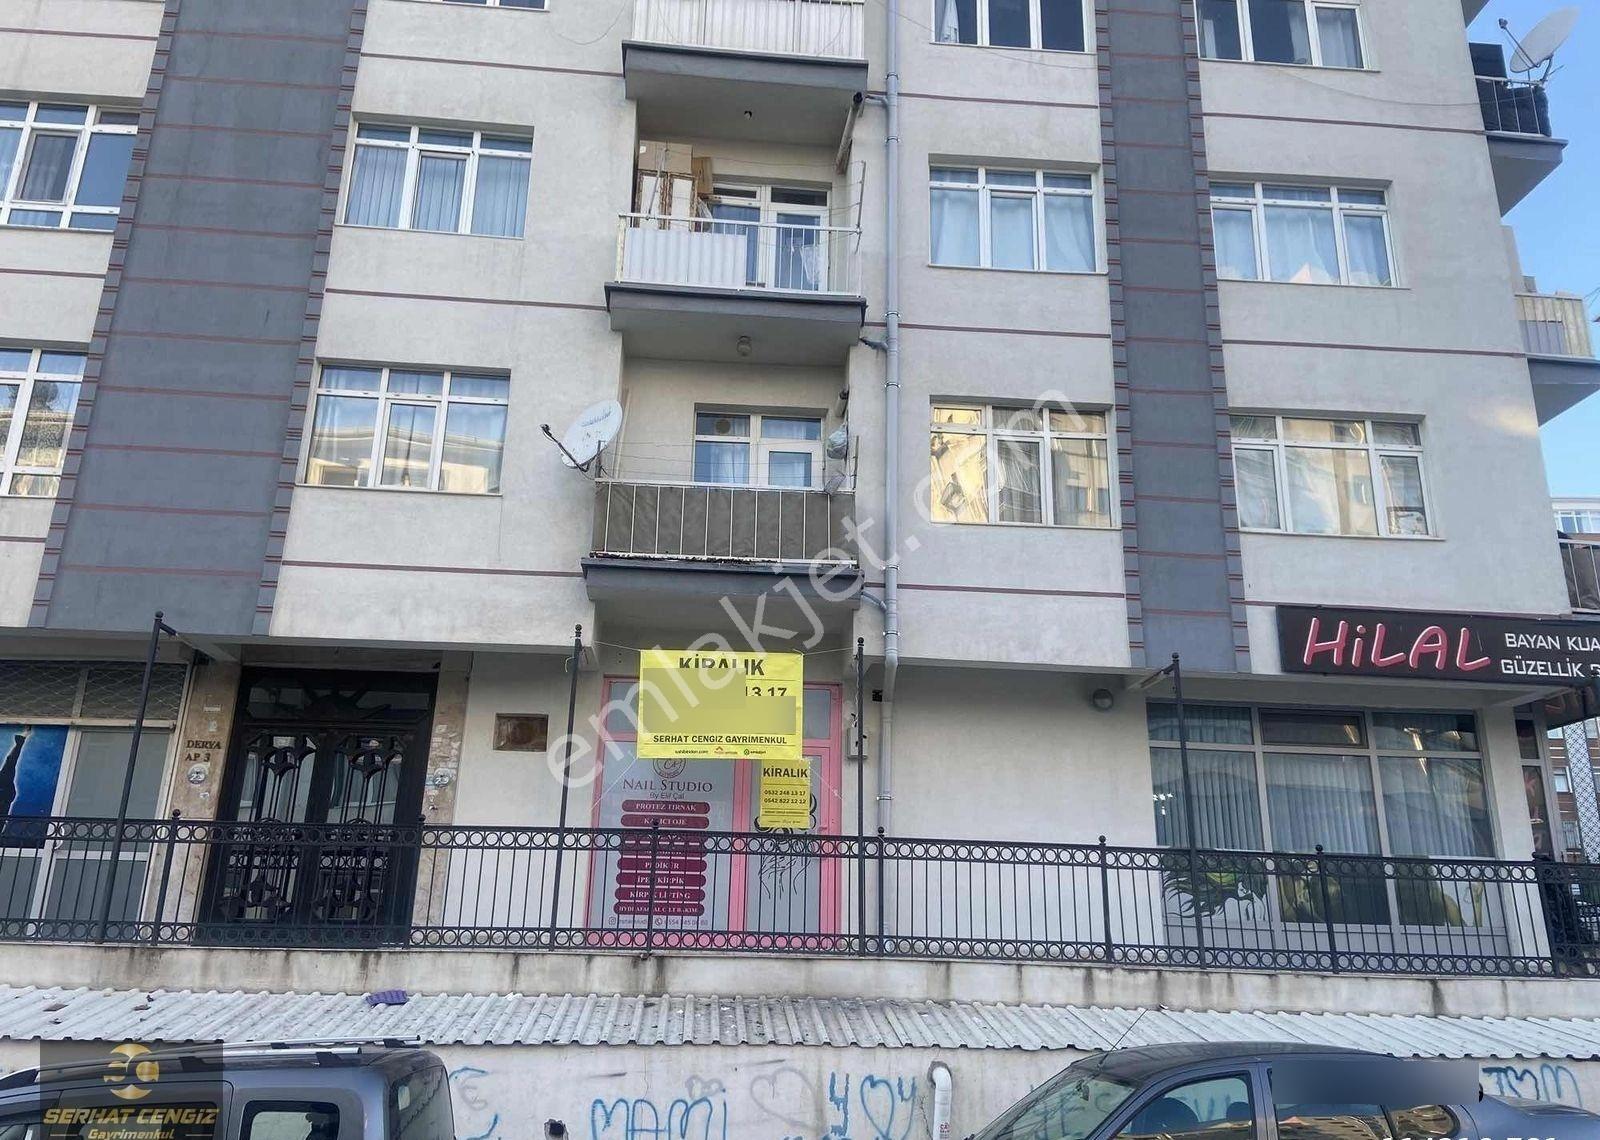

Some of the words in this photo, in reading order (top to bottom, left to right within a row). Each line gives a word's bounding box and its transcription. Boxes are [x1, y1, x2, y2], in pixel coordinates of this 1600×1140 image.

[1504, 633, 1561, 650] BAYAN
[1501, 655, 1586, 678] GÜZELLİK
[186, 739, 221, 749] DERYA
[653, 735, 689, 743] SERHAT
[725, 735, 787, 744] GAYRİMENKUL
[185, 753, 200, 761] AP
[763, 765, 808, 778] KİRALIK
[623, 778, 656, 790] NAIL
[660, 779, 713, 792] STUDIO
